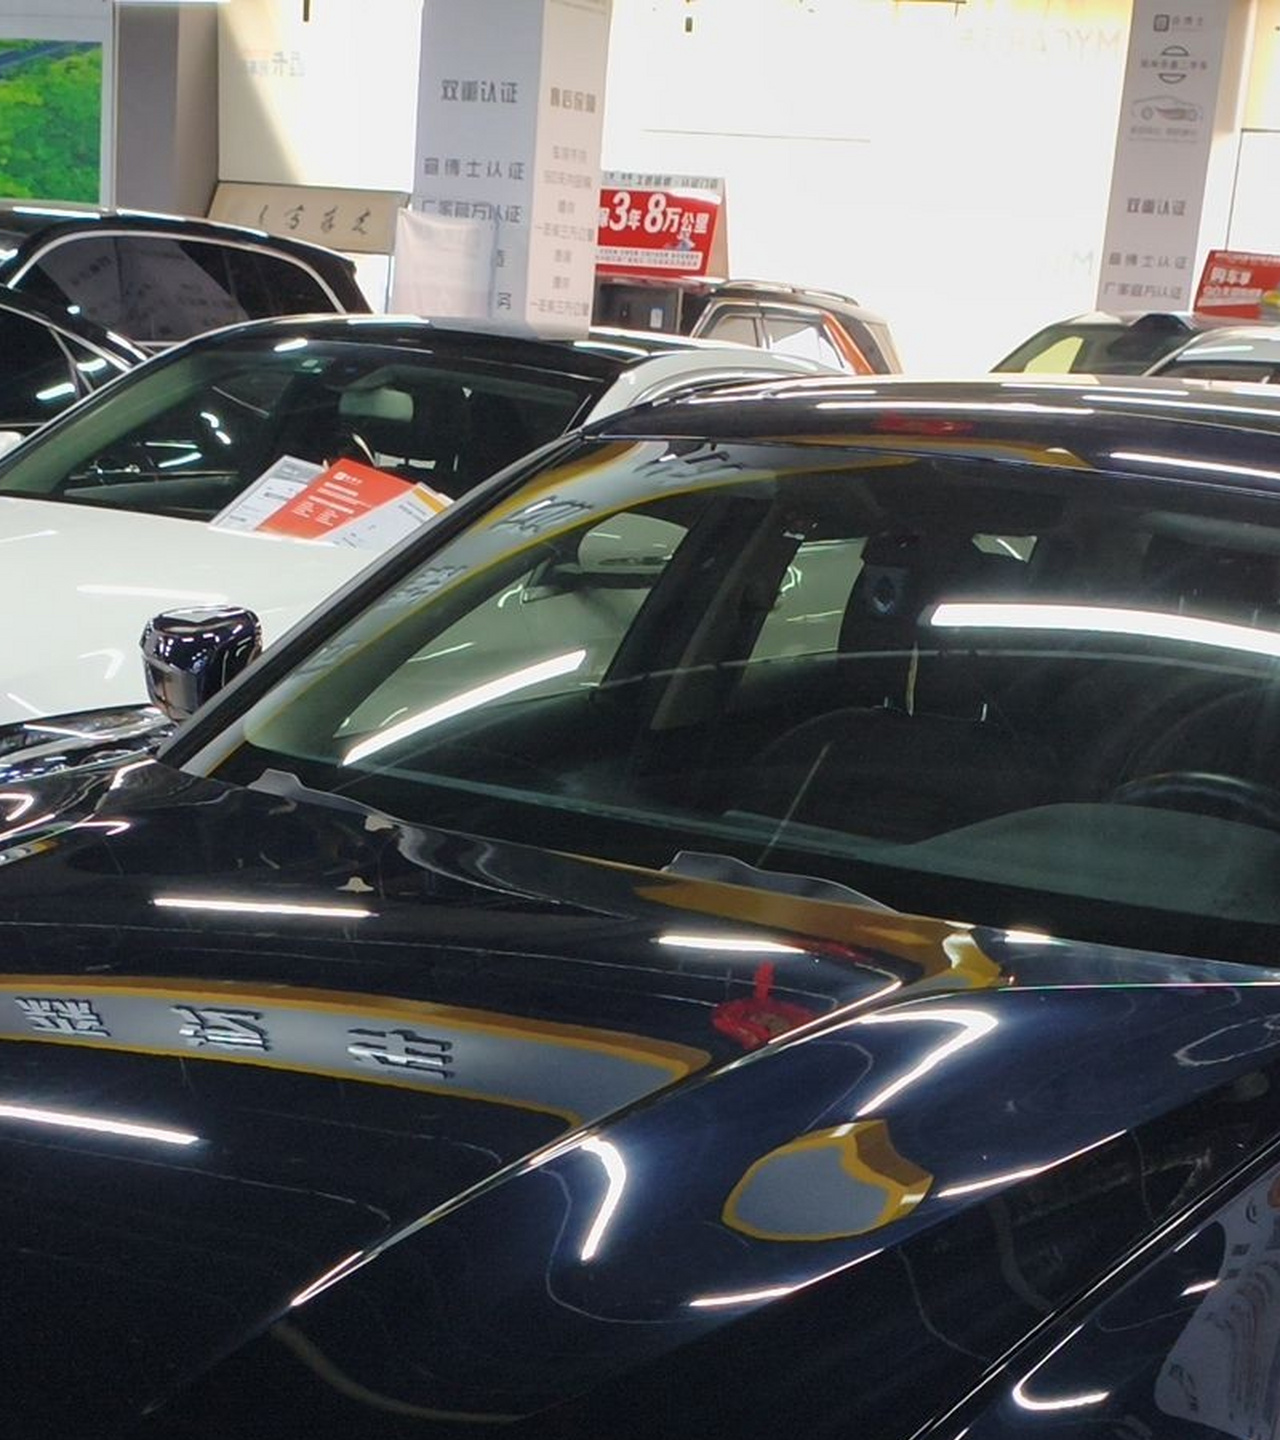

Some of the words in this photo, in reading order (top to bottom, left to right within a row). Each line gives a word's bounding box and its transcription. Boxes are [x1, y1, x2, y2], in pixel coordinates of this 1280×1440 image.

[440, 80, 518, 103] 双重认证
[1127, 198, 1186, 216] 双重认证
